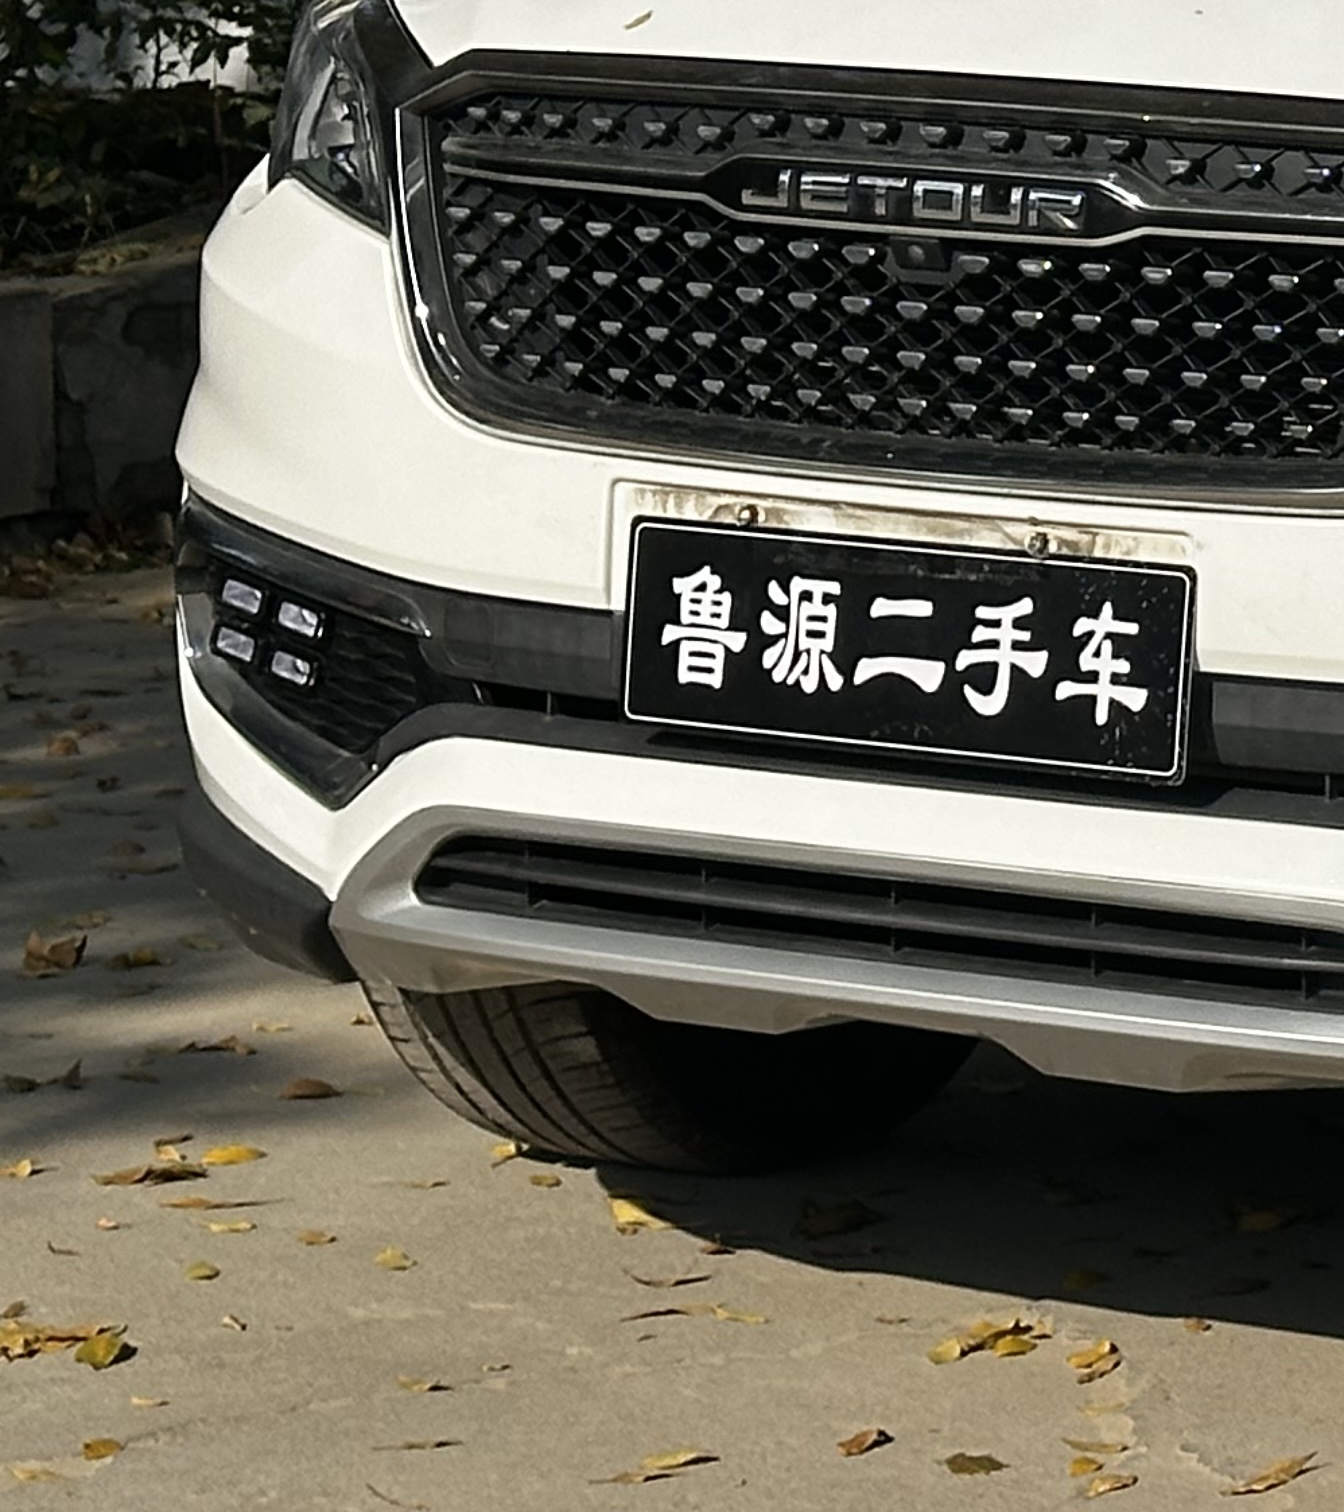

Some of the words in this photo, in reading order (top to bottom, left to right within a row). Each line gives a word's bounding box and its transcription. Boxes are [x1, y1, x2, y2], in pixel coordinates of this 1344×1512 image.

[741, 168, 1085, 230] JETOUR
[661, 565, 1149, 727] 鲁源二手车
